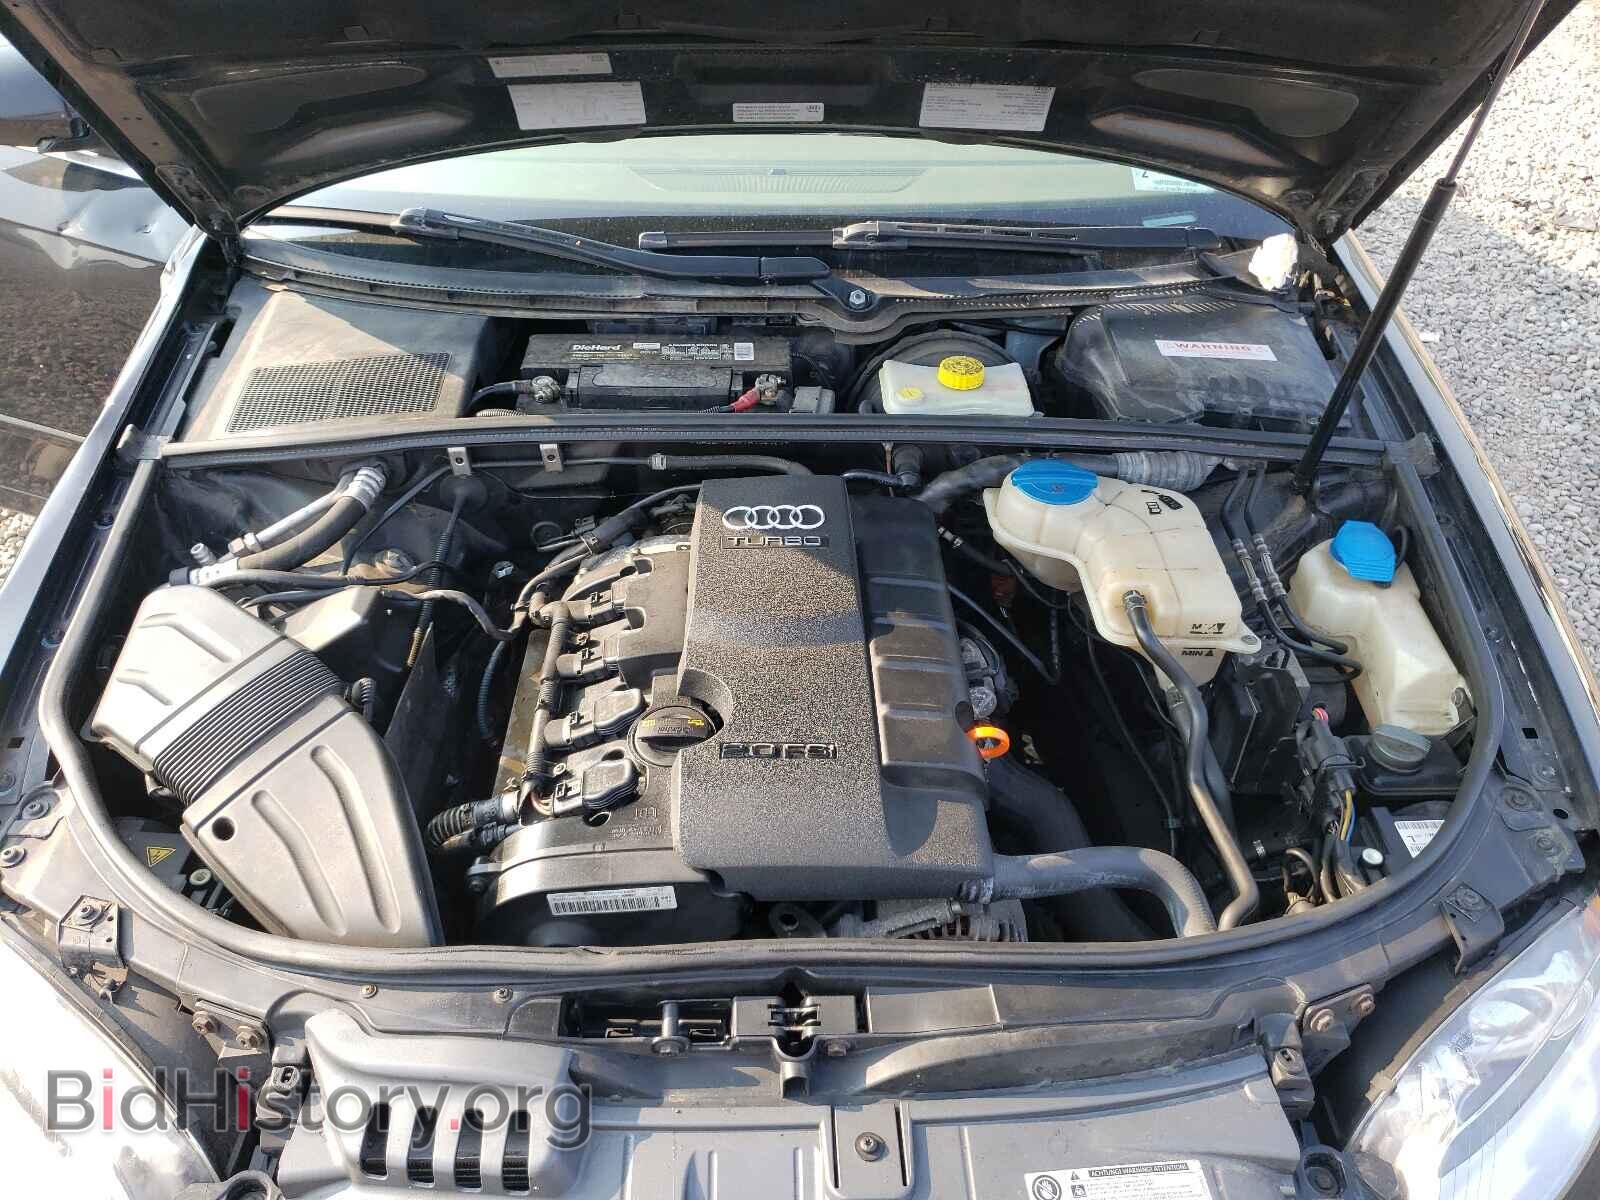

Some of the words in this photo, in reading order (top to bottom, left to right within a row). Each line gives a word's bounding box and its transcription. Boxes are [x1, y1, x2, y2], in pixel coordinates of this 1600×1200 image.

[1175, 343, 1250, 352] WARNING
[727, 535, 821, 546] TURBO
[1191, 623, 1216, 631] MX
